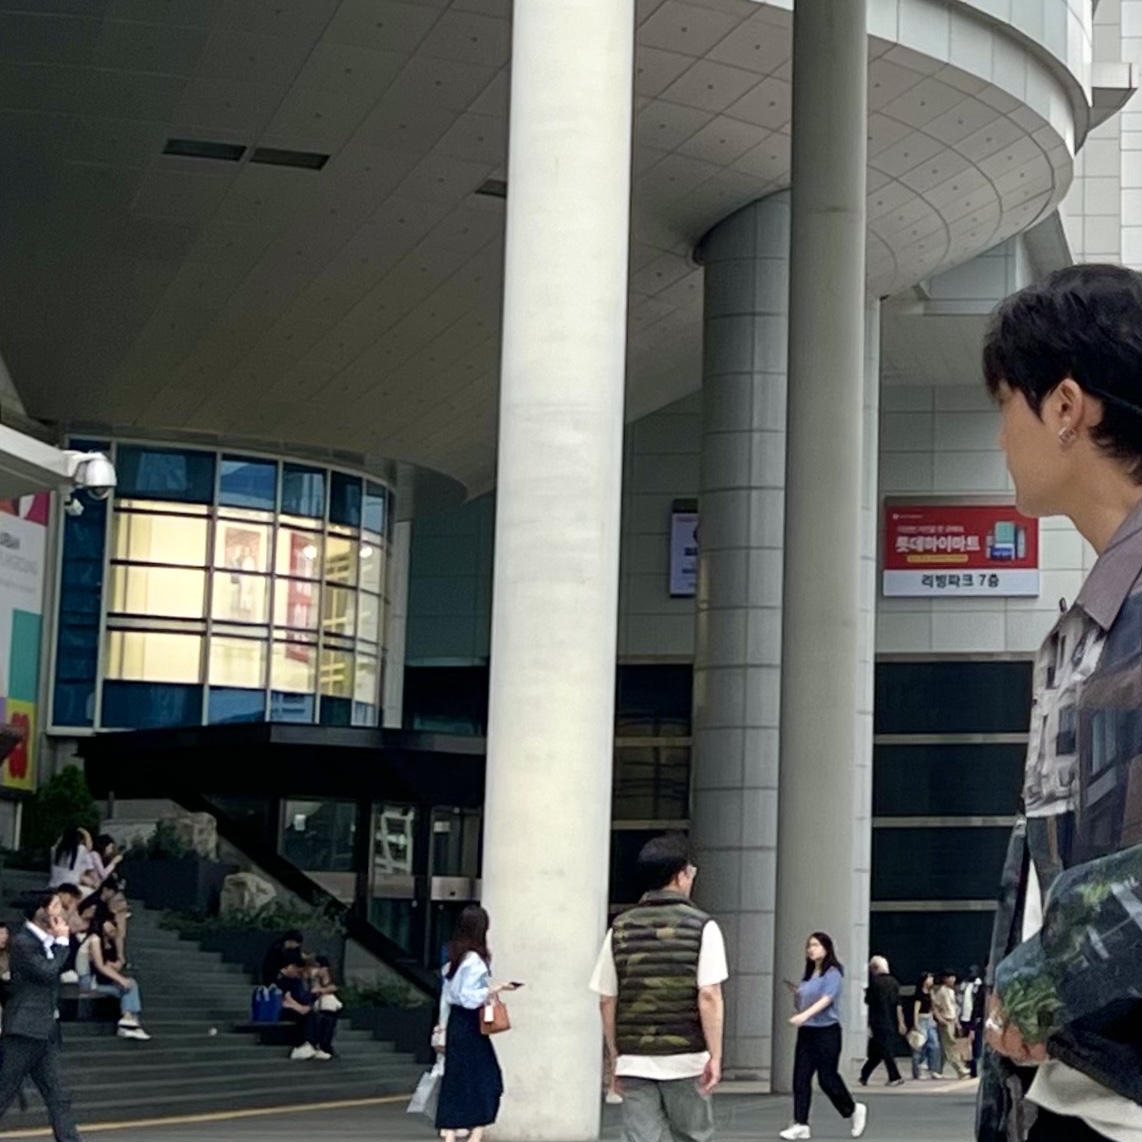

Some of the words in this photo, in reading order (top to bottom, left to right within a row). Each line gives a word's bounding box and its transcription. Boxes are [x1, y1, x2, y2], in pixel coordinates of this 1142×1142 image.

[895, 535, 980, 552] 롯데하이마트
[921, 573, 974, 588] 리빙파크
[979, 573, 999, 588] 7층
